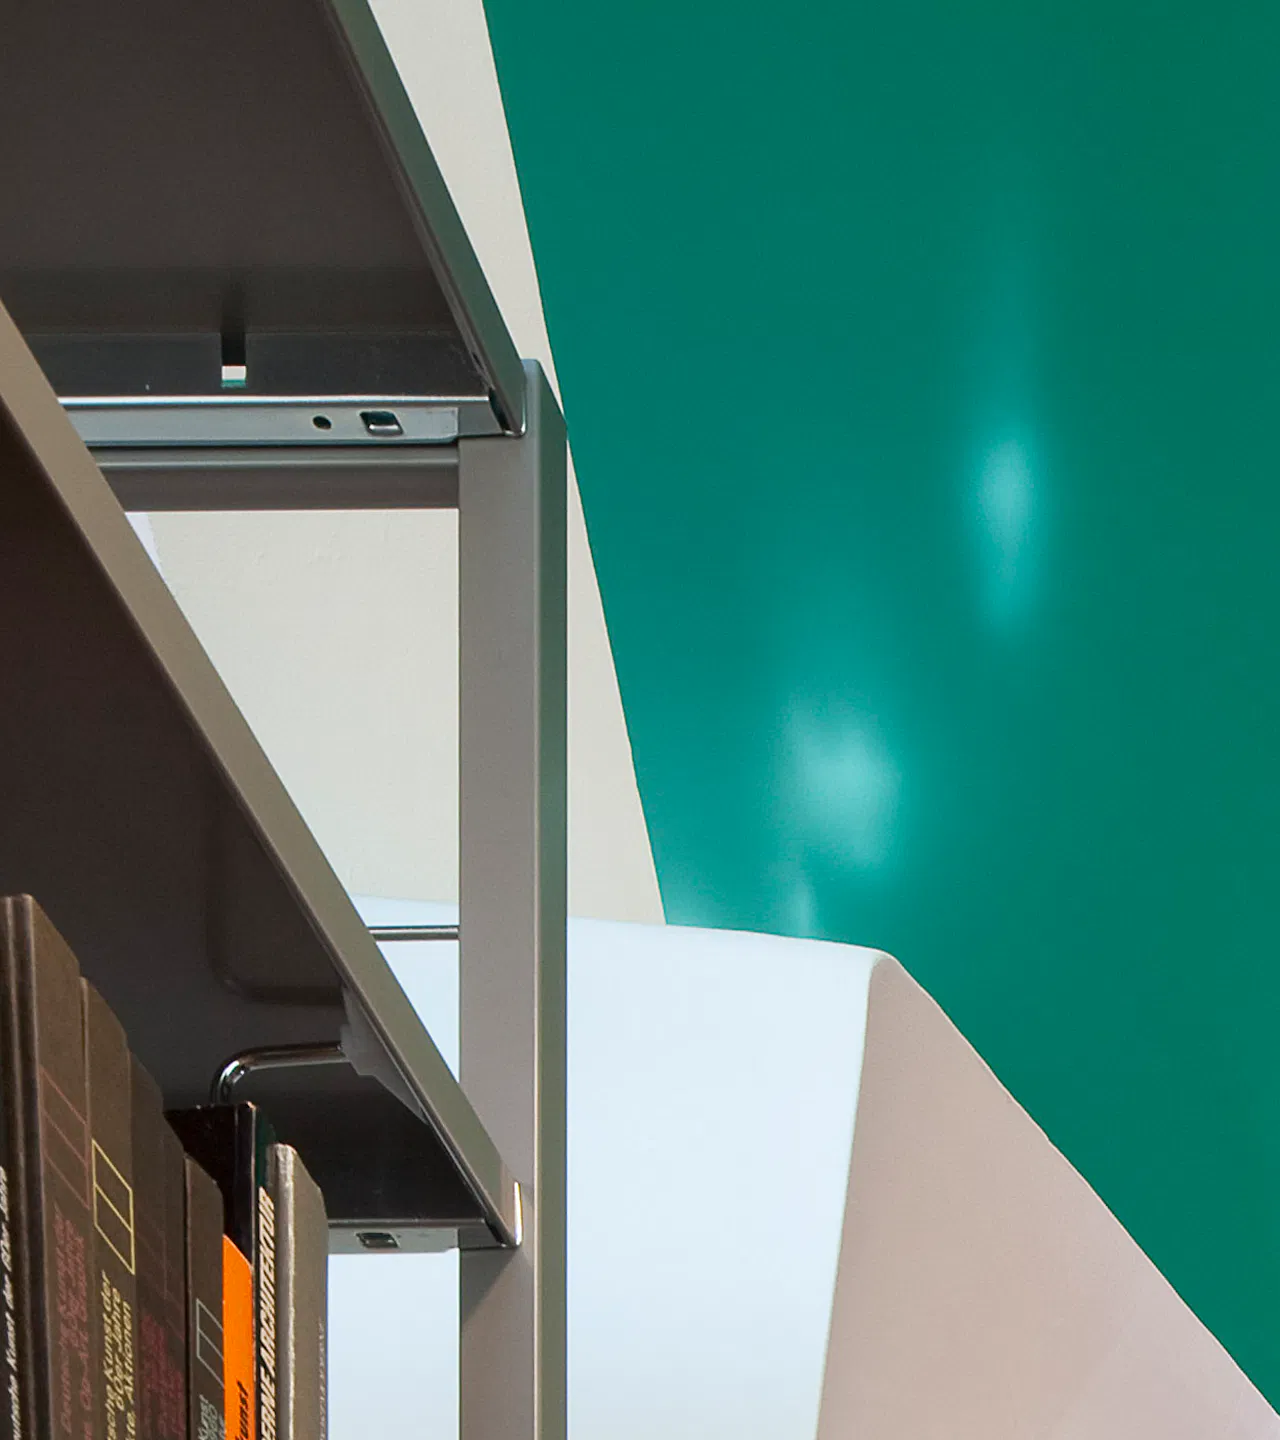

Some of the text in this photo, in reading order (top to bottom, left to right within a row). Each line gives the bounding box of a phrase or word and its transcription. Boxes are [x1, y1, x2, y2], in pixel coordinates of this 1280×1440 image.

[101, 1270, 115, 1312] der
[257, 1192, 277, 1374] ARCHITEKTUR
[103, 1312, 118, 1380] Kunst
[111, 1287, 124, 1358] Jahre
[121, 1300, 135, 1405] Aktionen
